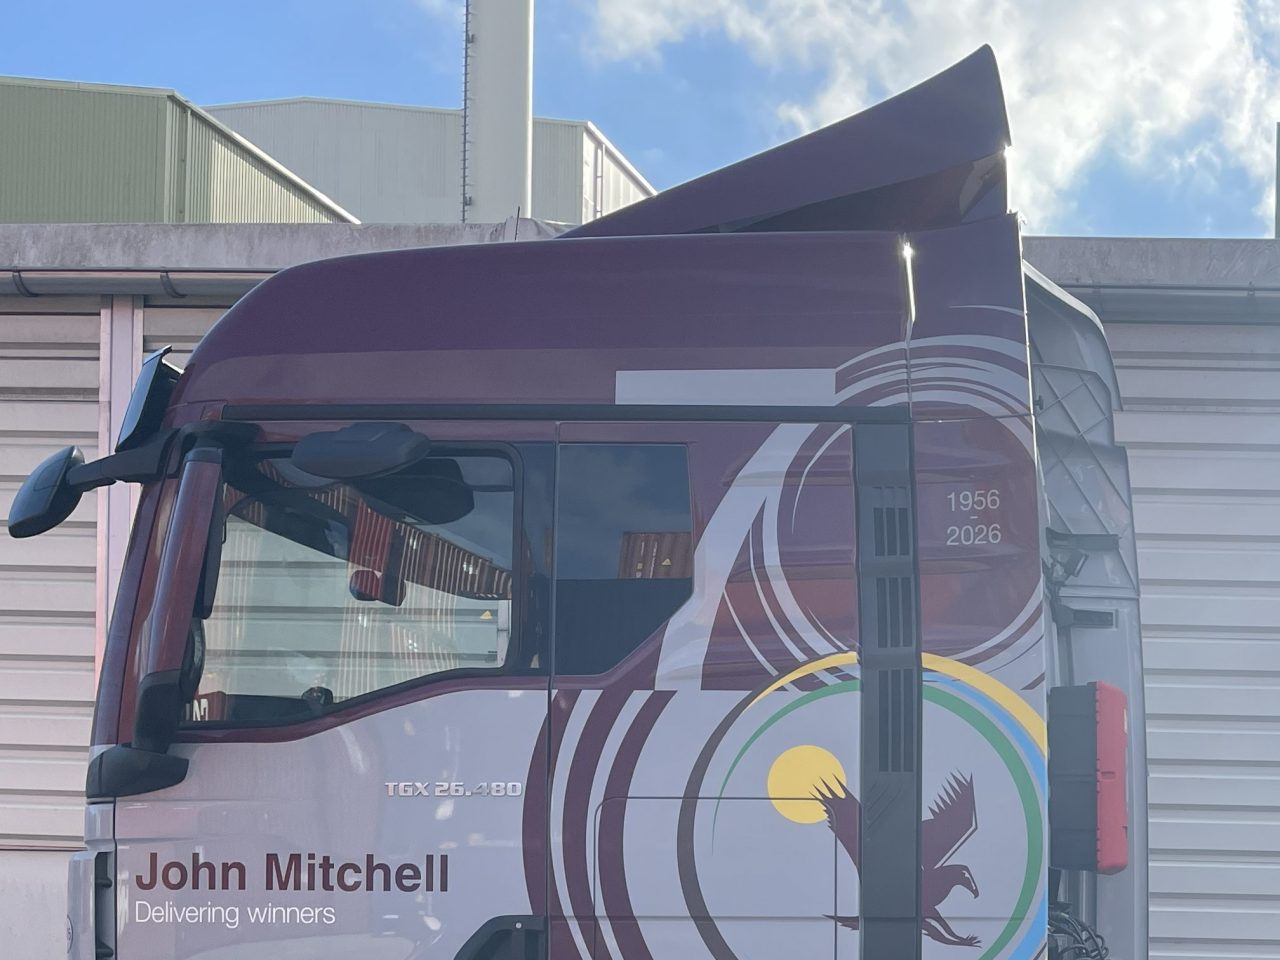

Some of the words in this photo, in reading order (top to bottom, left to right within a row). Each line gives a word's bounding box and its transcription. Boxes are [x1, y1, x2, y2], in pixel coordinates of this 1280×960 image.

[946, 489, 1001, 512] 1956
[946, 524, 1002, 546] 2026
[384, 782, 430, 797] TGX
[434, 782, 523, 797] 26.480
[135, 852, 247, 891] John
[265, 853, 449, 893] Mitchell
[135, 900, 240, 929] Delivering
[247, 902, 336, 925] winners
